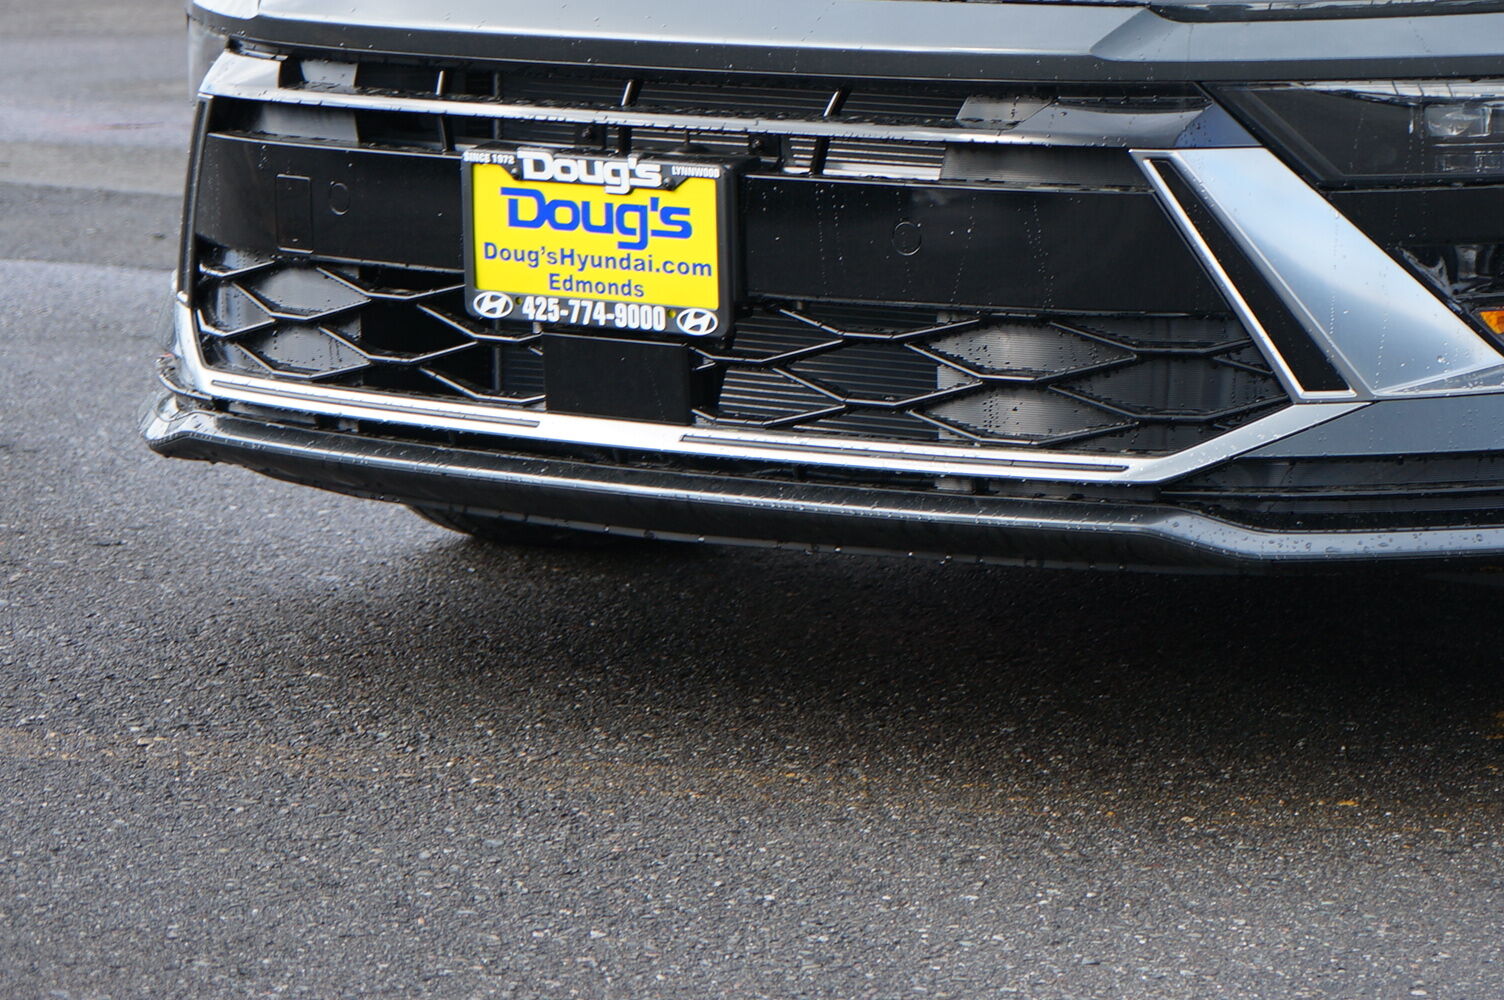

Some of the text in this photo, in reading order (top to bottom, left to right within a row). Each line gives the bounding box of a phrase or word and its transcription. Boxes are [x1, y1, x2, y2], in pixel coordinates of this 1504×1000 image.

[463, 151, 515, 165] SINCE 1972
[517, 150, 663, 195] Doug's
[671, 165, 720, 178] LYNNWOOD
[501, 187, 693, 250] Doug's
[484, 242, 712, 276] Doug'sHyundai.com
[549, 273, 645, 297] Edmonds
[522, 296, 666, 331] 425-774-9000
